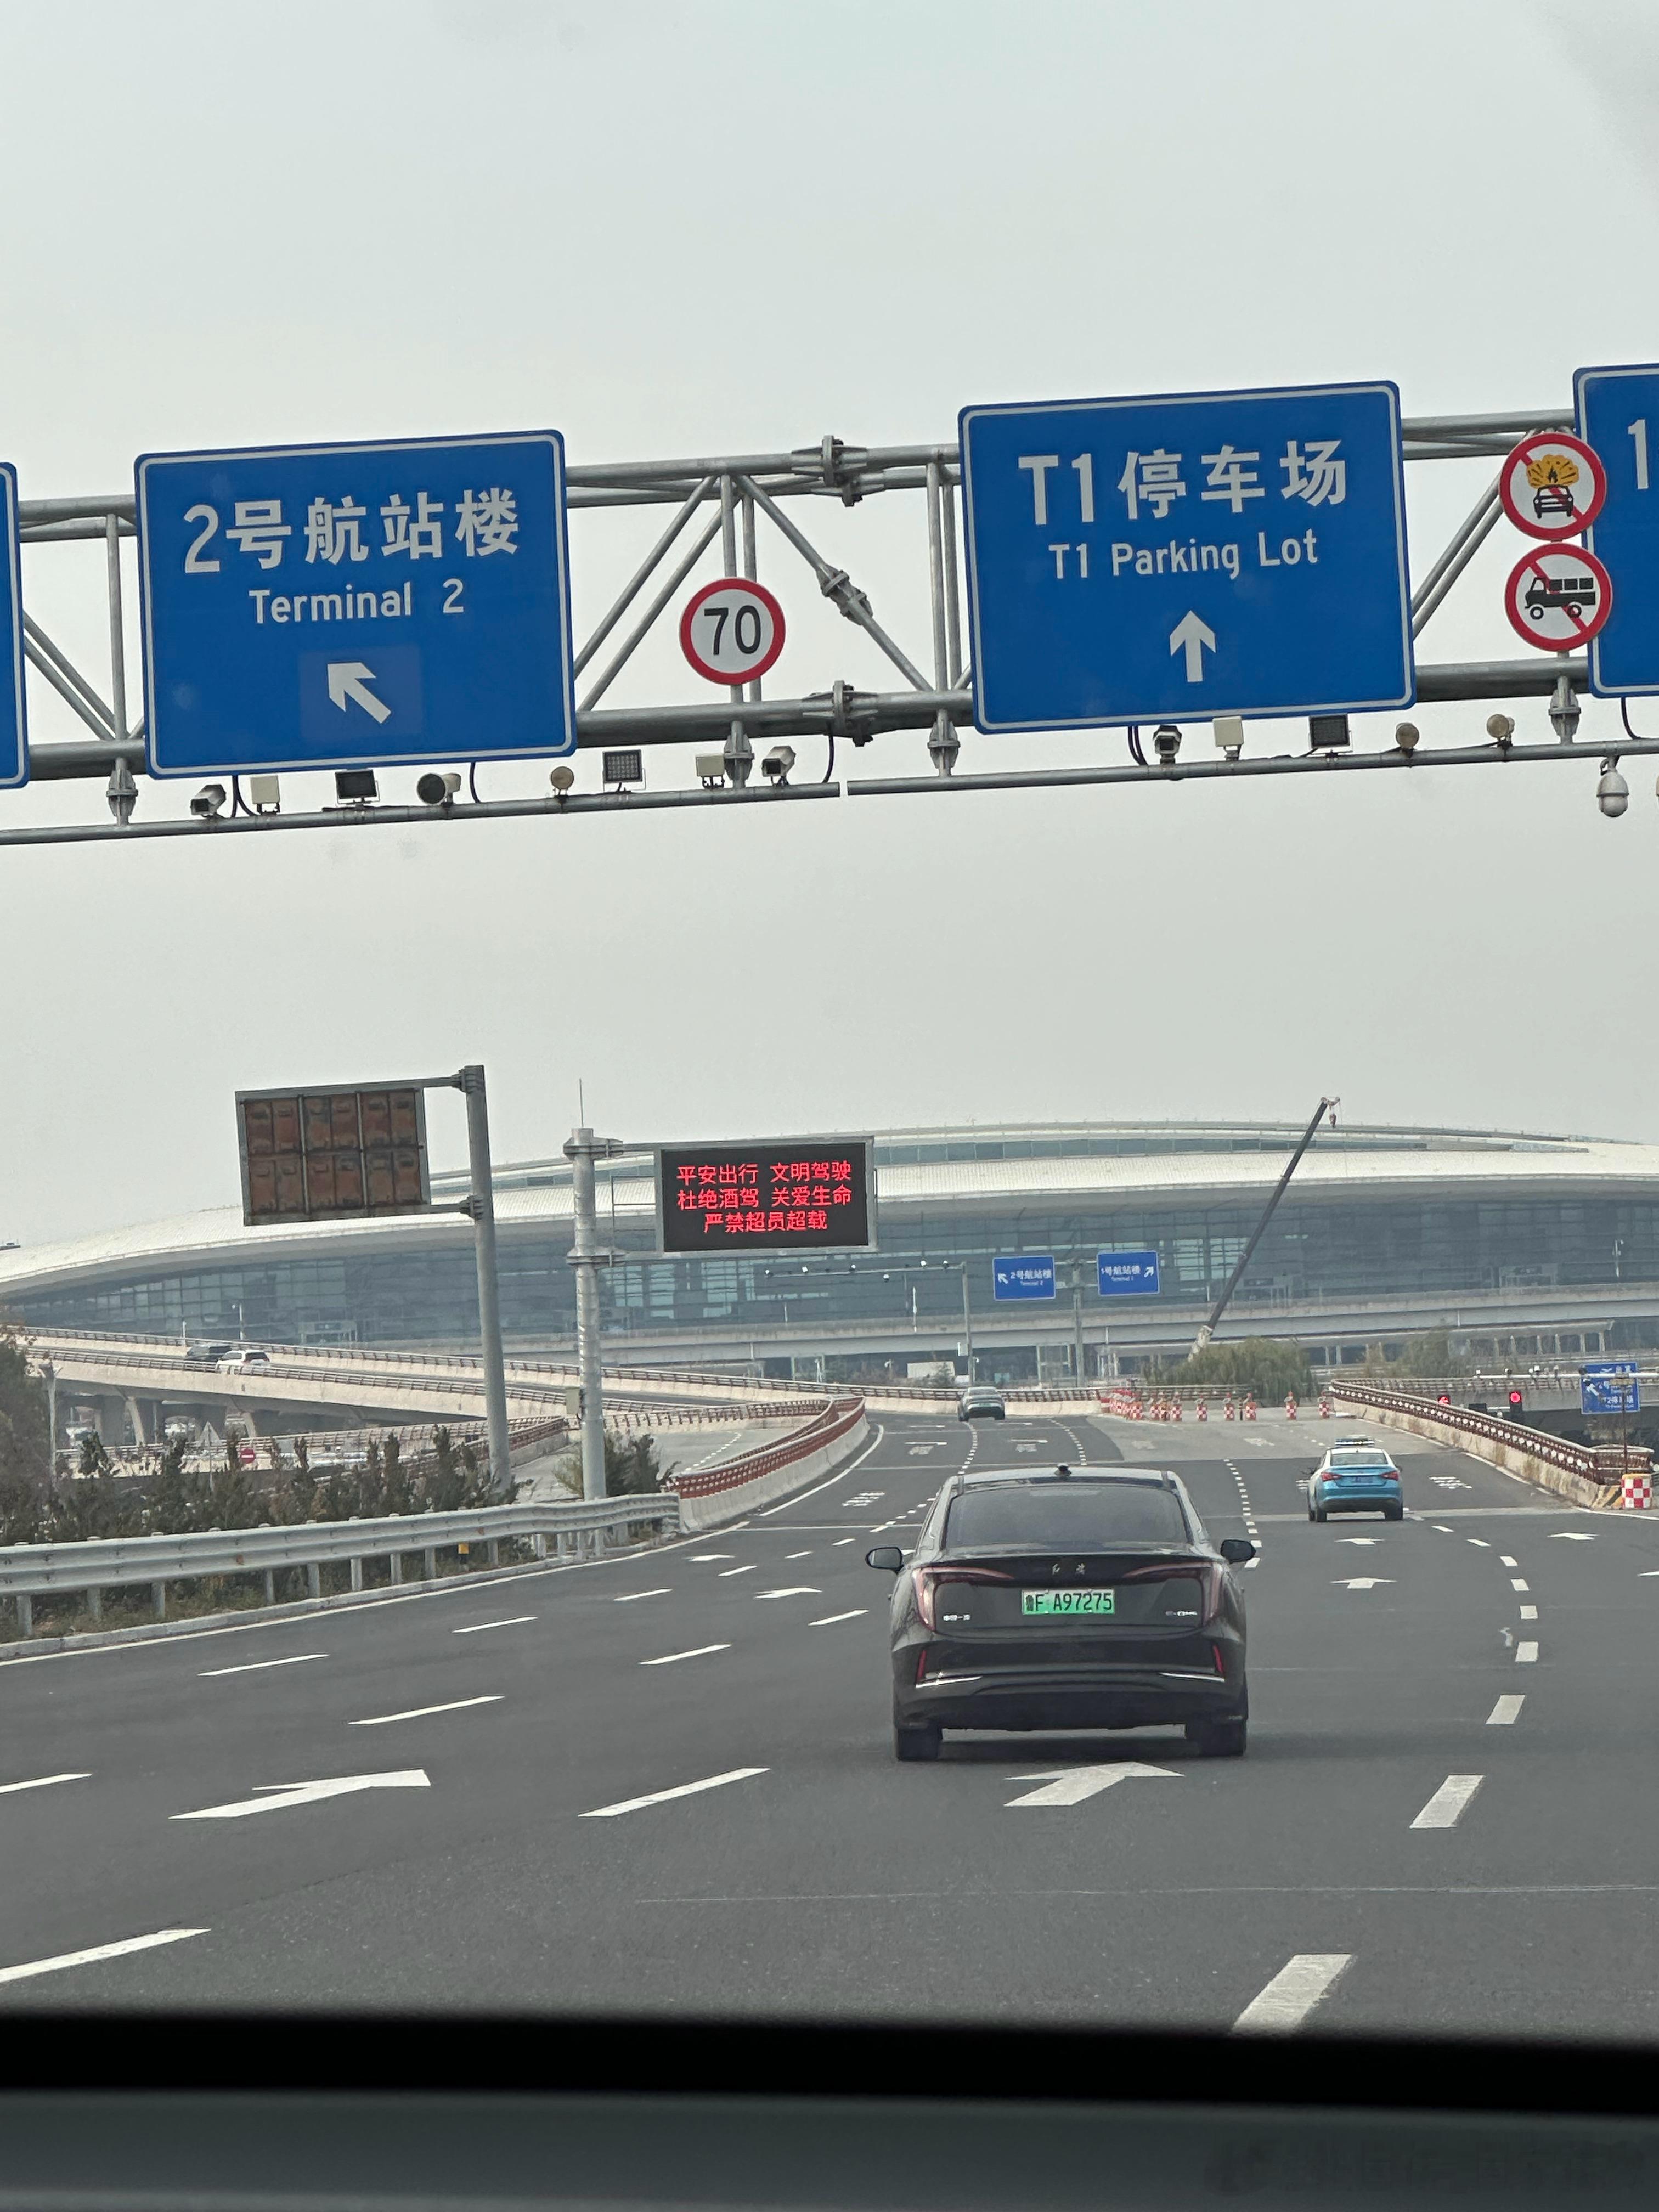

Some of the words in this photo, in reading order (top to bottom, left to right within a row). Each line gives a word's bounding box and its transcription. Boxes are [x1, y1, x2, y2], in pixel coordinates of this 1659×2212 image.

[1018, 440, 1346, 526] T1停车场
[183, 488, 519, 574] 2号航站楼
[1048, 543, 1088, 579] T1
[1111, 538, 1240, 580] Parking
[1257, 528, 1318, 567] Lot
[249, 582, 411, 624] Terminal
[442, 578, 465, 614] 2
[703, 605, 762, 656] 70
[676, 1163, 759, 1186] 平安出行
[770, 1159, 852, 1182] 文明驾驶
[677, 1187, 760, 1211] 杜绝酒驾
[771, 1183, 853, 1207] 关爱生命
[703, 1210, 828, 1234] 严禁超员超载
[1053, 1593, 1113, 1611] A97275
